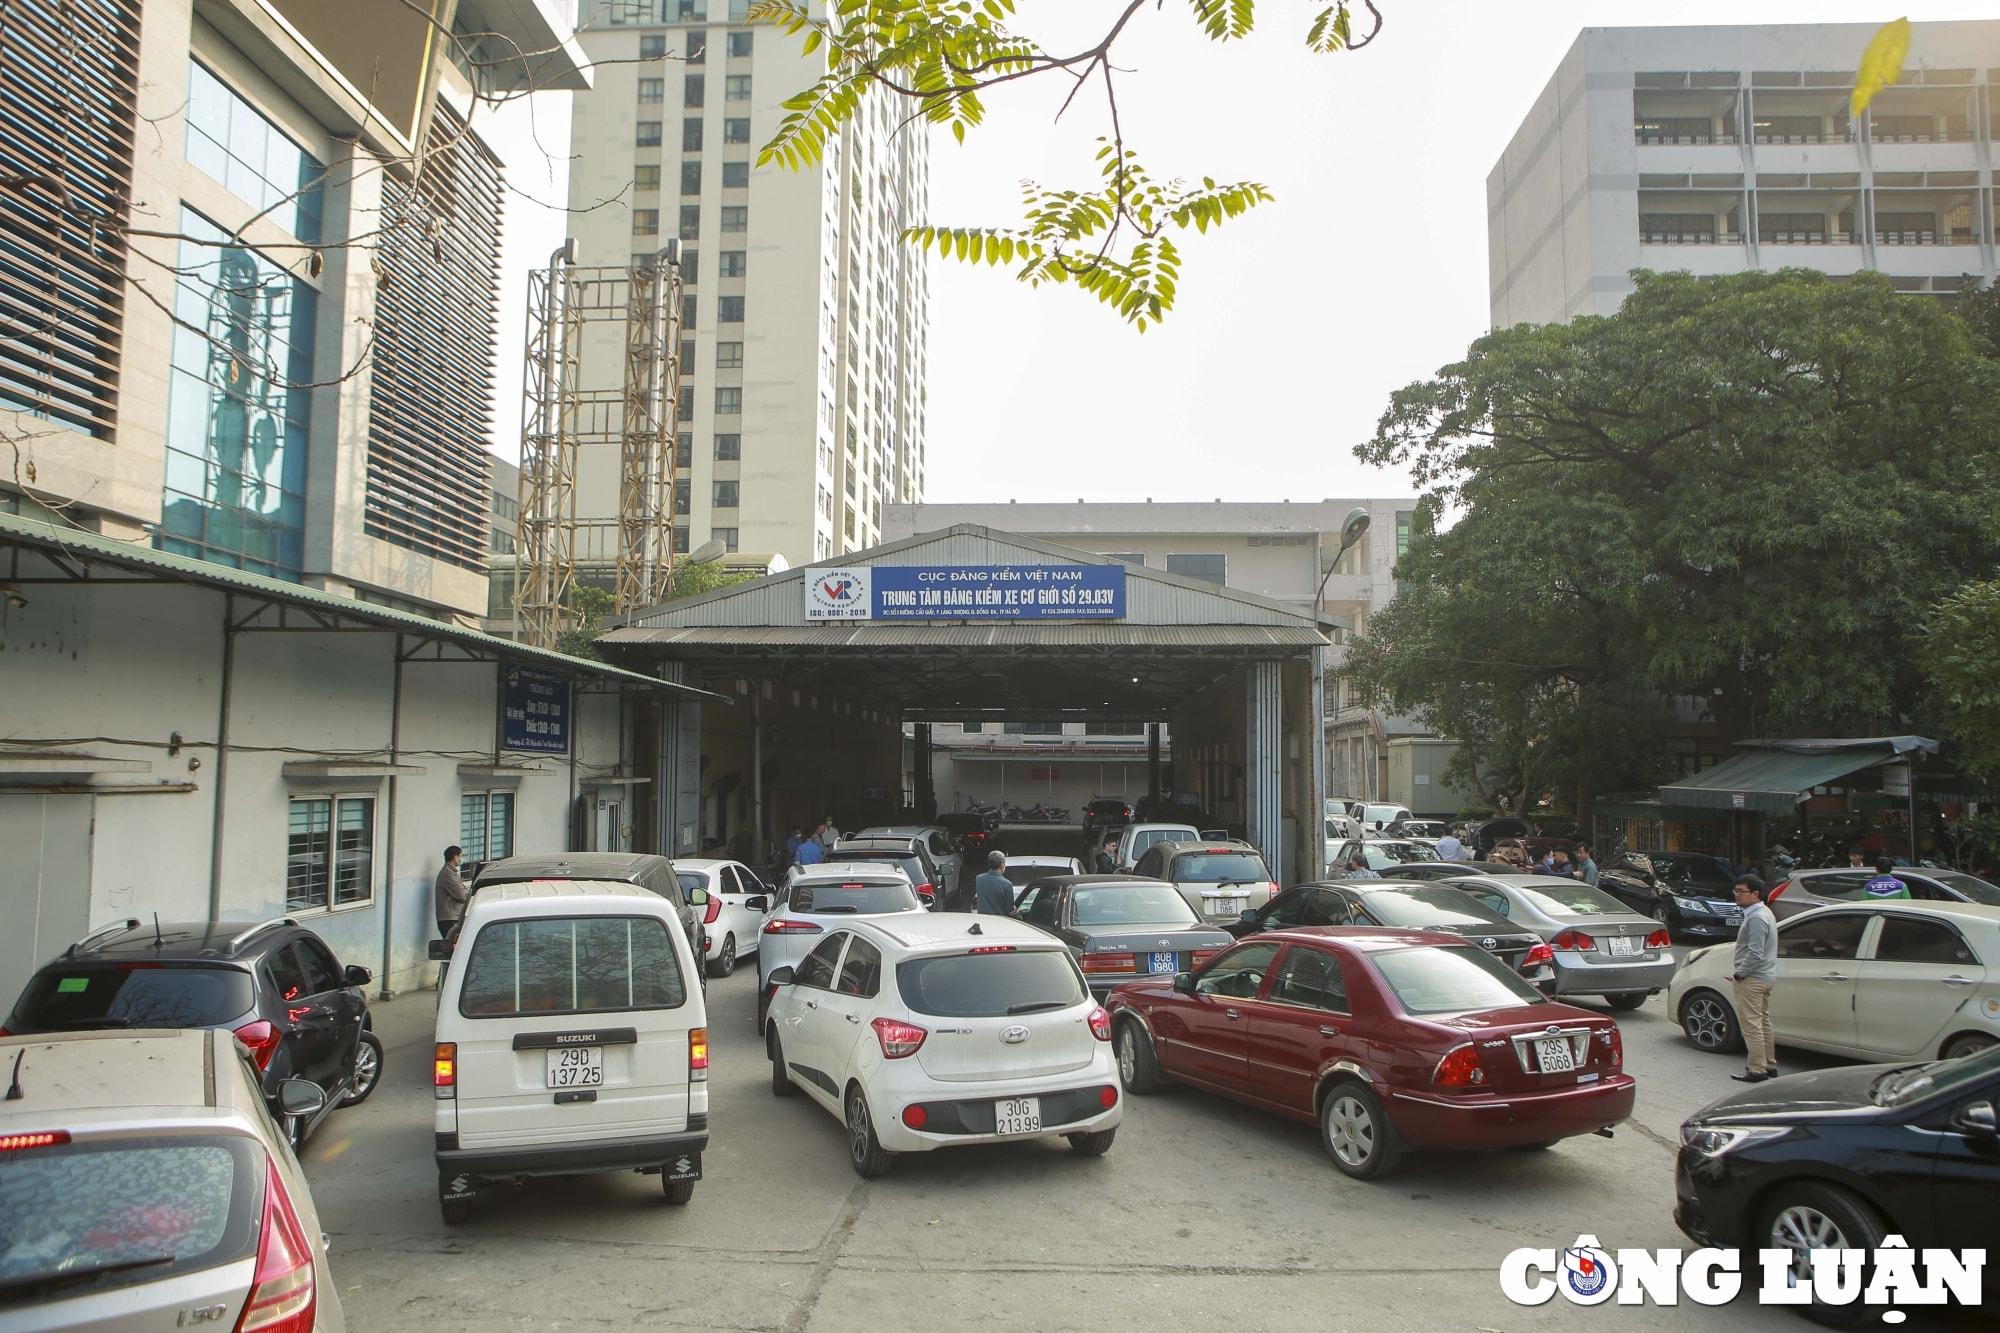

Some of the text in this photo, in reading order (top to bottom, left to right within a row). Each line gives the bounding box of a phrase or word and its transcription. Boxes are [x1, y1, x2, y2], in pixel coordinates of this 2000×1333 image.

[918, 567, 1082, 583] CỤC ĐĂNG KIỂM VIỆT NAM
[882, 583, 1114, 606] TRUNG TÂM ĐĂNG KIỂM XE CƠ GIỚI SỐ 29.03V
[810, 609, 825, 617] ISO:
[1155, 952, 1171, 962] 80B
[1153, 962, 1174, 972] 1980
[556, 1034, 596, 1043] SUZUKI
[1543, 1040, 1563, 1055] 29S
[561, 1049, 589, 1066] 29D
[1543, 1055, 1571, 1071] 5068
[551, 1066, 601, 1086] 137.25
[1006, 1100, 1030, 1117] 30G
[998, 1116, 1040, 1134] 213.99
[669, 1172, 699, 1180] SUZUKI
[443, 1191, 476, 1200] SUZUKI
